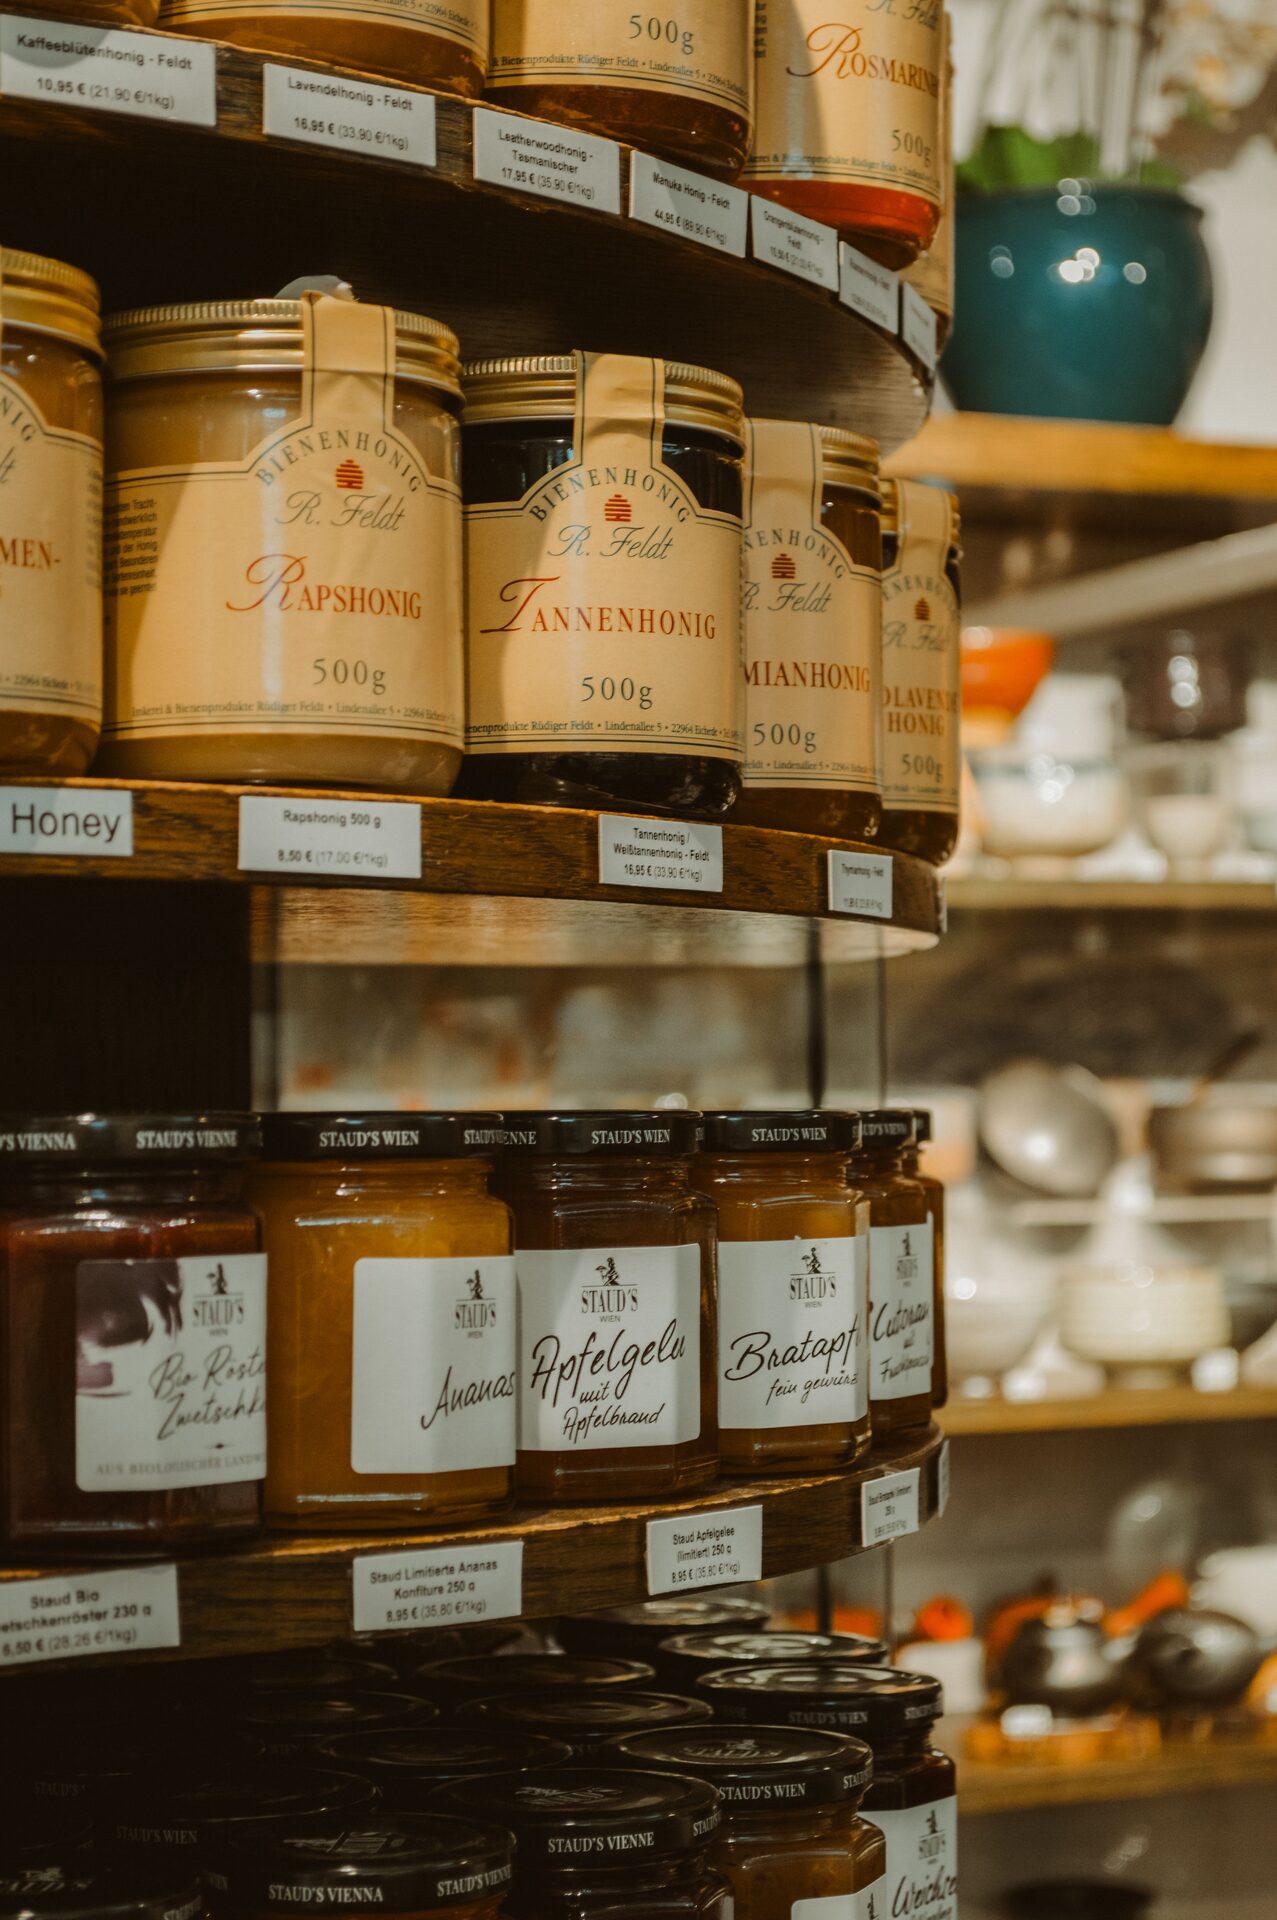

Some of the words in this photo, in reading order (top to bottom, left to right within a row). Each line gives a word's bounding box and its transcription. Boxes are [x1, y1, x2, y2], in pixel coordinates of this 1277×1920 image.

[629, 14, 694, 56] 500g
[16, 34, 145, 67] Kaffeeblütenhonig
[157, 53, 192, 70] Feldt
[501, 55, 575, 67] Bienenprodukte
[577, 54, 614, 66] Rüdiger
[616, 55, 639, 68] Feldt
[36, 77, 74, 95] 10,95
[77, 83, 86, 95] €
[89, 84, 131, 104] (21.90
[134, 90, 175, 110] €/1kg)
[288, 76, 373, 106] Lavendelhonig
[384, 94, 413, 111] Feldt
[294, 117, 325, 133] 16,95
[328, 122, 335, 135] €
[338, 125, 372, 143] (33.90
[375, 129, 409, 151] €/1kg)
[498, 128, 587, 162] Leatherwoodhonig
[892, 129, 932, 168] 500g
[511, 149, 579, 174] Tasmanischer
[502, 167, 527, 183] 17,95
[529, 172, 536, 185] €
[652, 171, 683, 193] Manuka
[684, 183, 706, 204] Honig
[711, 192, 731, 211] Feldt
[654, 208, 675, 226] 44,95
[675, 216, 682, 228] €
[254, 428, 422, 493] BIENENHONIG
[529, 466, 691, 523] BIENENHONIG
[275, 491, 323, 526] R.
[330, 494, 406, 531] Feldt
[547, 525, 592, 556] R.
[599, 525, 674, 560] Feldt
[225, 553, 422, 620] RAPSHONIG
[768, 581, 833, 613] Feldt
[479, 576, 717, 640] TANNENHONIG
[312, 657, 387, 696] 500g
[581, 676, 653, 710] 500g
[175, 702, 254, 716] Bienenprodukte
[257, 700, 297, 714] Rüdiger
[300, 701, 324, 713] Feldt
[531, 719, 568, 732] Rüdiger
[570, 720, 593, 731] Feldt
[605, 720, 655, 732] Lindenallee
[656, 722, 663, 733] 5
[887, 711, 945, 736] HONIG
[753, 722, 817, 753] 500g
[11, 802, 122, 843] Honey
[283, 809, 347, 827] Rapshonig
[350, 813, 370, 826] 500
[374, 816, 382, 828] g
[633, 827, 686, 845] Tannenhonig
[277, 849, 302, 863] 8,50
[305, 850, 312, 862] €
[613, 843, 683, 861] Weißtannenhonig
[690, 849, 710, 862] Feldt
[624, 863, 646, 877] 16,95
[646, 866, 653, 876] €
[17, 1132, 77, 1151] VIENNA
[136, 1130, 196, 1149] STAUD'S
[319, 1130, 381, 1148] STAUD'S
[381, 1130, 420, 1146] WIEN
[591, 1130, 643, 1145] STAUD'S
[642, 1129, 671, 1145] WIEN
[751, 1128, 800, 1143] STAUD'S
[800, 1127, 827, 1142] WIEN
[789, 1275, 837, 1301] STAUD'S
[192, 1299, 245, 1328] STAUD'S
[581, 1288, 639, 1314] STAUD'S
[454, 1302, 497, 1329] STAUD'S
[599, 1315, 622, 1323] WIEN
[149, 1352, 197, 1400] Bio
[420, 1365, 516, 1430] Ananas
[579, 1381, 610, 1405] mit
[766, 1377, 798, 1406] fein
[563, 1402, 666, 1444] Apfelbrand
[673, 1531, 695, 1545] Staud
[696, 1525, 735, 1542] Apfelgelee
[711, 1543, 725, 1557] 250
[370, 1571, 401, 1585] Staud
[404, 1564, 455, 1581] Limitierte
[458, 1559, 498, 1574] Ananas
[671, 1570, 687, 1584] 8,95
[688, 1568, 693, 1580] €
[30, 1591, 71, 1610] Staud
[76, 1589, 100, 1604] Bio
[447, 1580, 466, 1594] 250
[113, 1604, 138, 1619] 230
[386, 1607, 409, 1623] 8,95
[411, 1606, 418, 1620] €
[35, 1638, 45, 1652] €
[719, 1785, 772, 1801] STAUD'S
[772, 1783, 806, 1798] WIEN
[548, 1836, 604, 1854] STAUD'S
[605, 1832, 655, 1850] VIENNE
[268, 1884, 325, 1903] STAUD'S
[327, 1886, 384, 1903] VIENNA
[437, 1873, 484, 1898] STAUD'S
